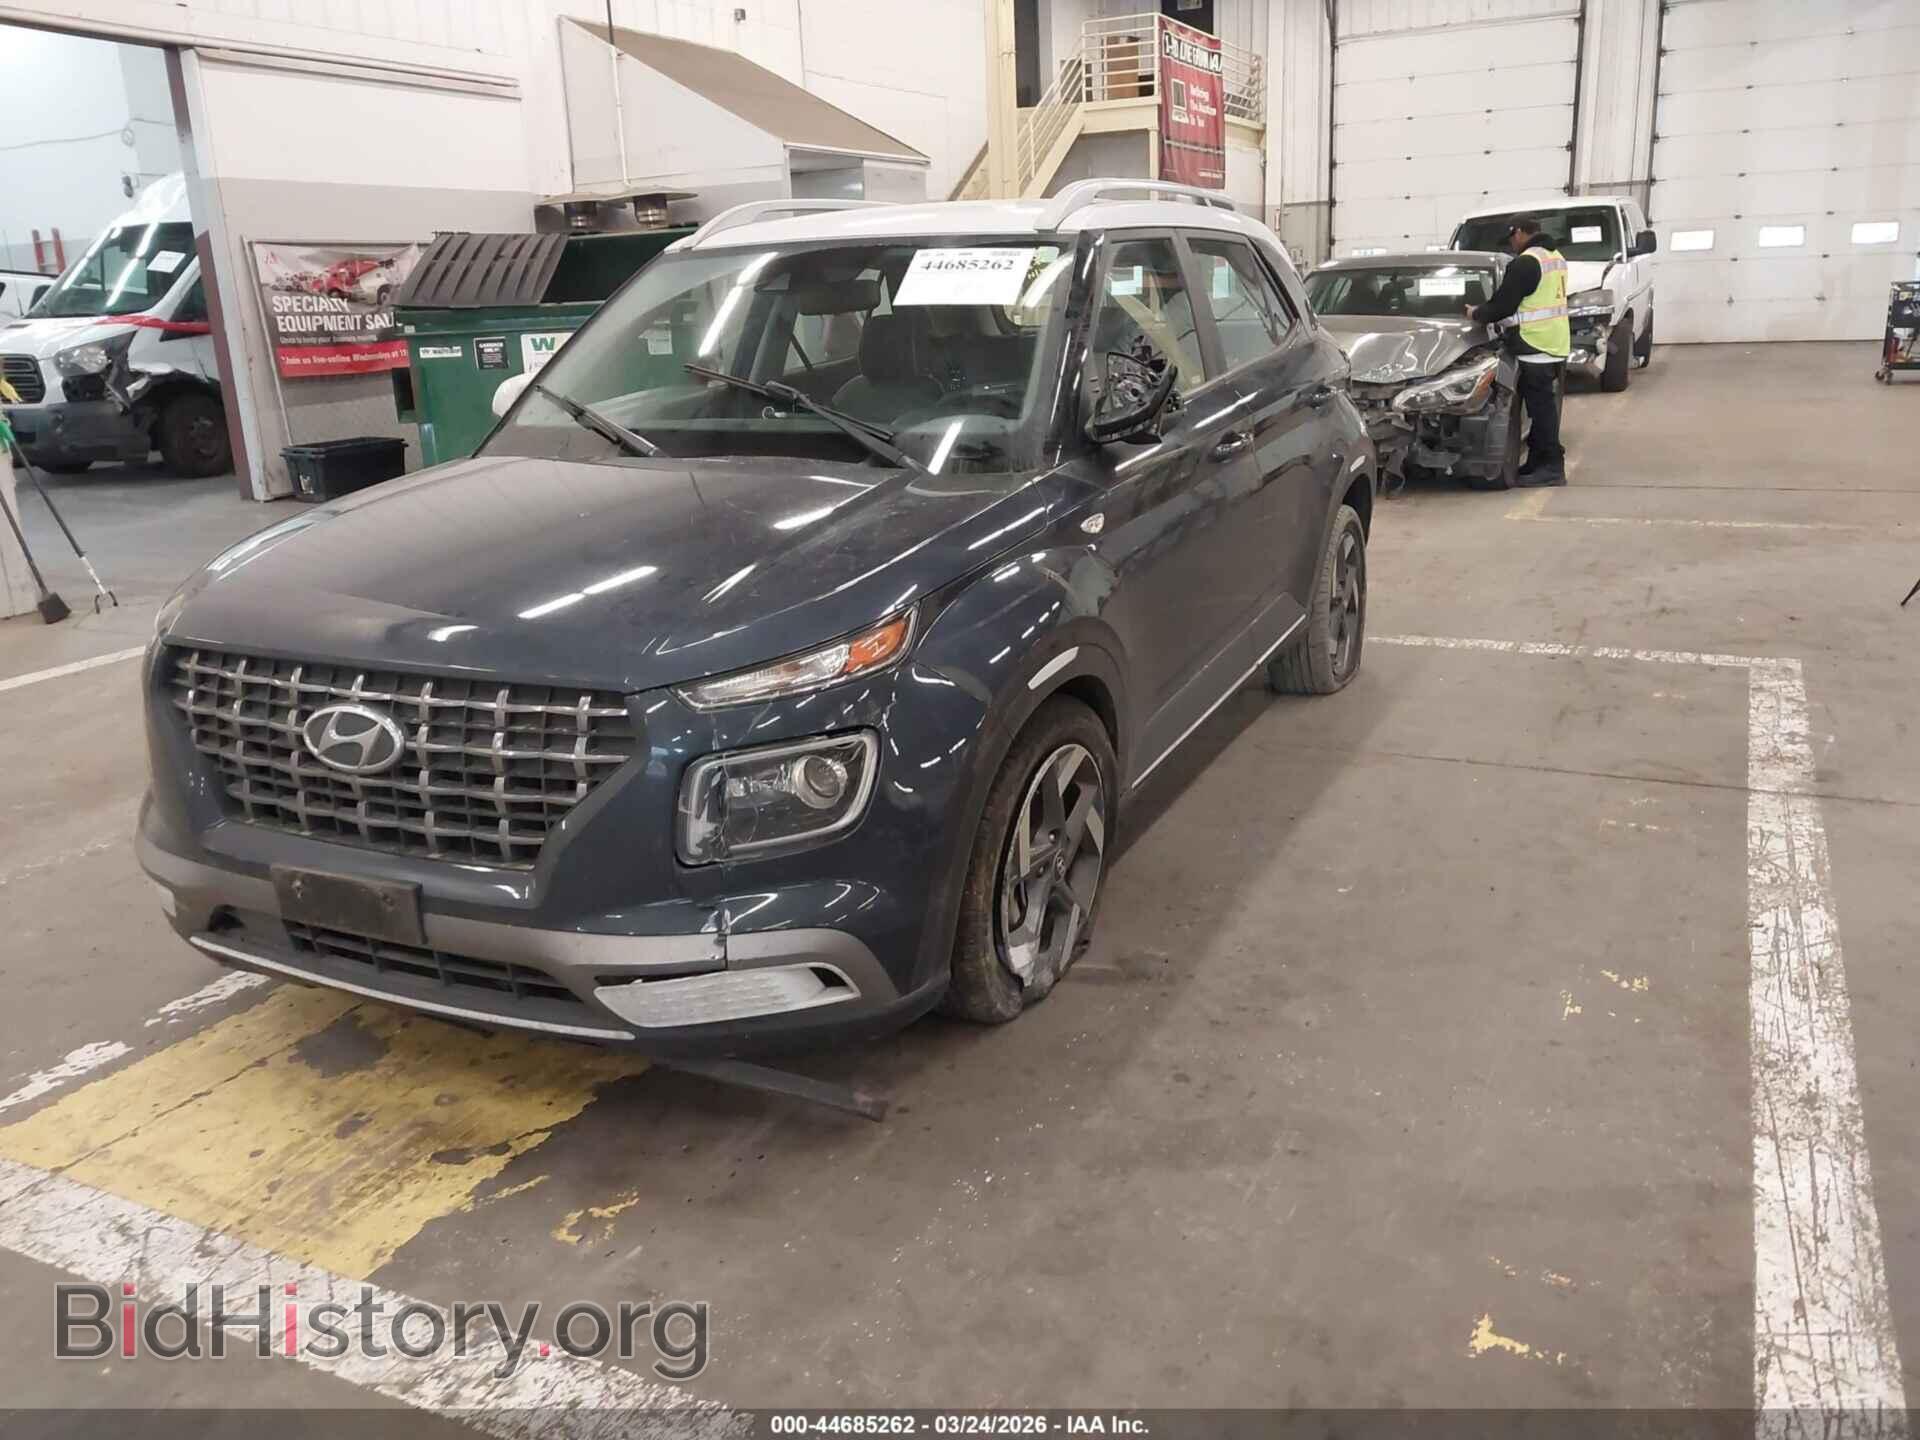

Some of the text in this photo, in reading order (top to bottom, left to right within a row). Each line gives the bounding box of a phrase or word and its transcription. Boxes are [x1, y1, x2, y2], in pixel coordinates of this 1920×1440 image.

[920, 259, 1014, 271] 44685262
[271, 295, 350, 313] SPECIALTY
[276, 314, 362, 333] EQUIPMENT
